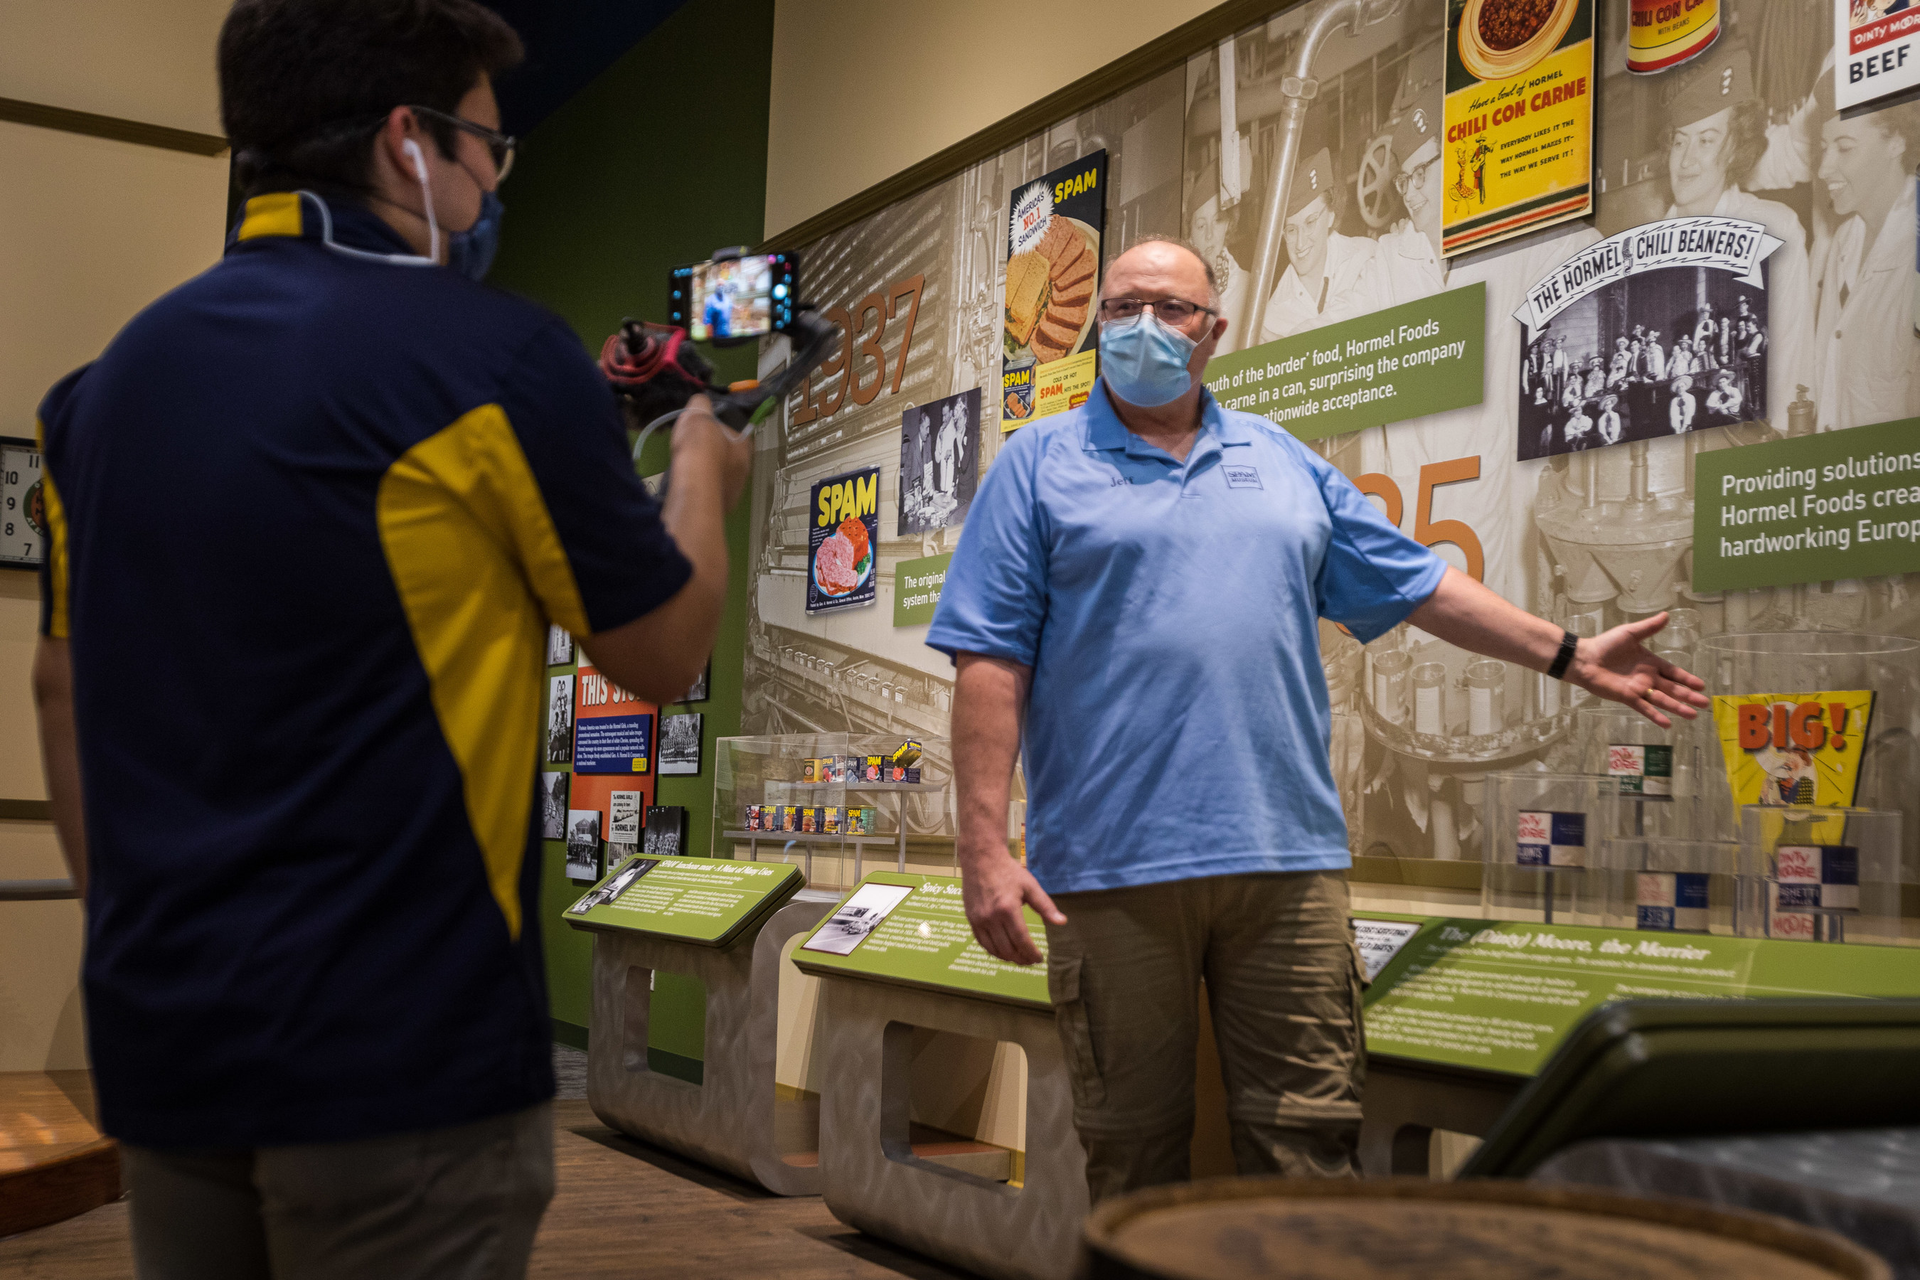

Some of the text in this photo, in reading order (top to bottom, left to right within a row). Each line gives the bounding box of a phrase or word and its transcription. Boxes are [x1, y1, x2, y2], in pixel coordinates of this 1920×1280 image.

[1632, 10, 1653, 27] CHILI
[1656, 2, 1681, 24] CON
[1658, 17, 1690, 35] WITH BEANS
[1850, 43, 1911, 84] BEEF
[1468, 97, 1489, 113] Have
[1497, 83, 1517, 101] bowl
[1516, 79, 1528, 96] of
[1529, 70, 1563, 88] HORMEL
[1447, 76, 1586, 143] CHILI CON CARNE
[1500, 119, 1574, 150] EVERYBODY LIKES IT THE
[1500, 155, 1513, 164] WAY
[1515, 146, 1538, 160] HORMEL
[1541, 139, 1562, 150] MAKES
[1500, 170, 1511, 179] THE
[1514, 163, 1526, 174] WAY
[1528, 161, 1538, 169] WE
[1540, 154, 1559, 165] SERVE
[1054, 168, 1097, 204] SPAM
[1018, 216, 1047, 247] SANDWICH
[1533, 229, 1754, 314] THE HORMEL CHILI BEANERS!
[1205, 374, 1229, 393] outh
[1232, 369, 1244, 387] of
[1246, 367, 1264, 384] the
[1312, 347, 1343, 367] food,
[1346, 329, 1395, 358] Hormel
[1398, 318, 1440, 343] Foods
[1004, 369, 1030, 388] SPAM
[1225, 340, 1465, 411] carne in a can, surprising the company
[1040, 383, 1063, 399] SPAM
[1263, 383, 1397, 423] ationwide acceptance.
[29, 455, 39, 468] 11
[1722, 452, 1920, 496] Providing solutions
[5, 471, 18, 485] 10
[1110, 476, 1135, 488] Jeff
[7, 497, 16, 510] 9
[818, 473, 877, 527] SPAM
[1721, 498, 1797, 527] Hormel
[1803, 489, 1866, 517] Foods
[5, 522, 14, 536] 8
[1720, 525, 1850, 557] hardworking
[24, 543, 32, 556] 7
[904, 570, 946, 590] The original
[903, 592, 927, 609] system
[582, 674, 608, 706] THIS
[1738, 702, 1846, 750] BIG!
[867, 756, 882, 766] SPAM
[920, 882, 944, 895] Spicy
